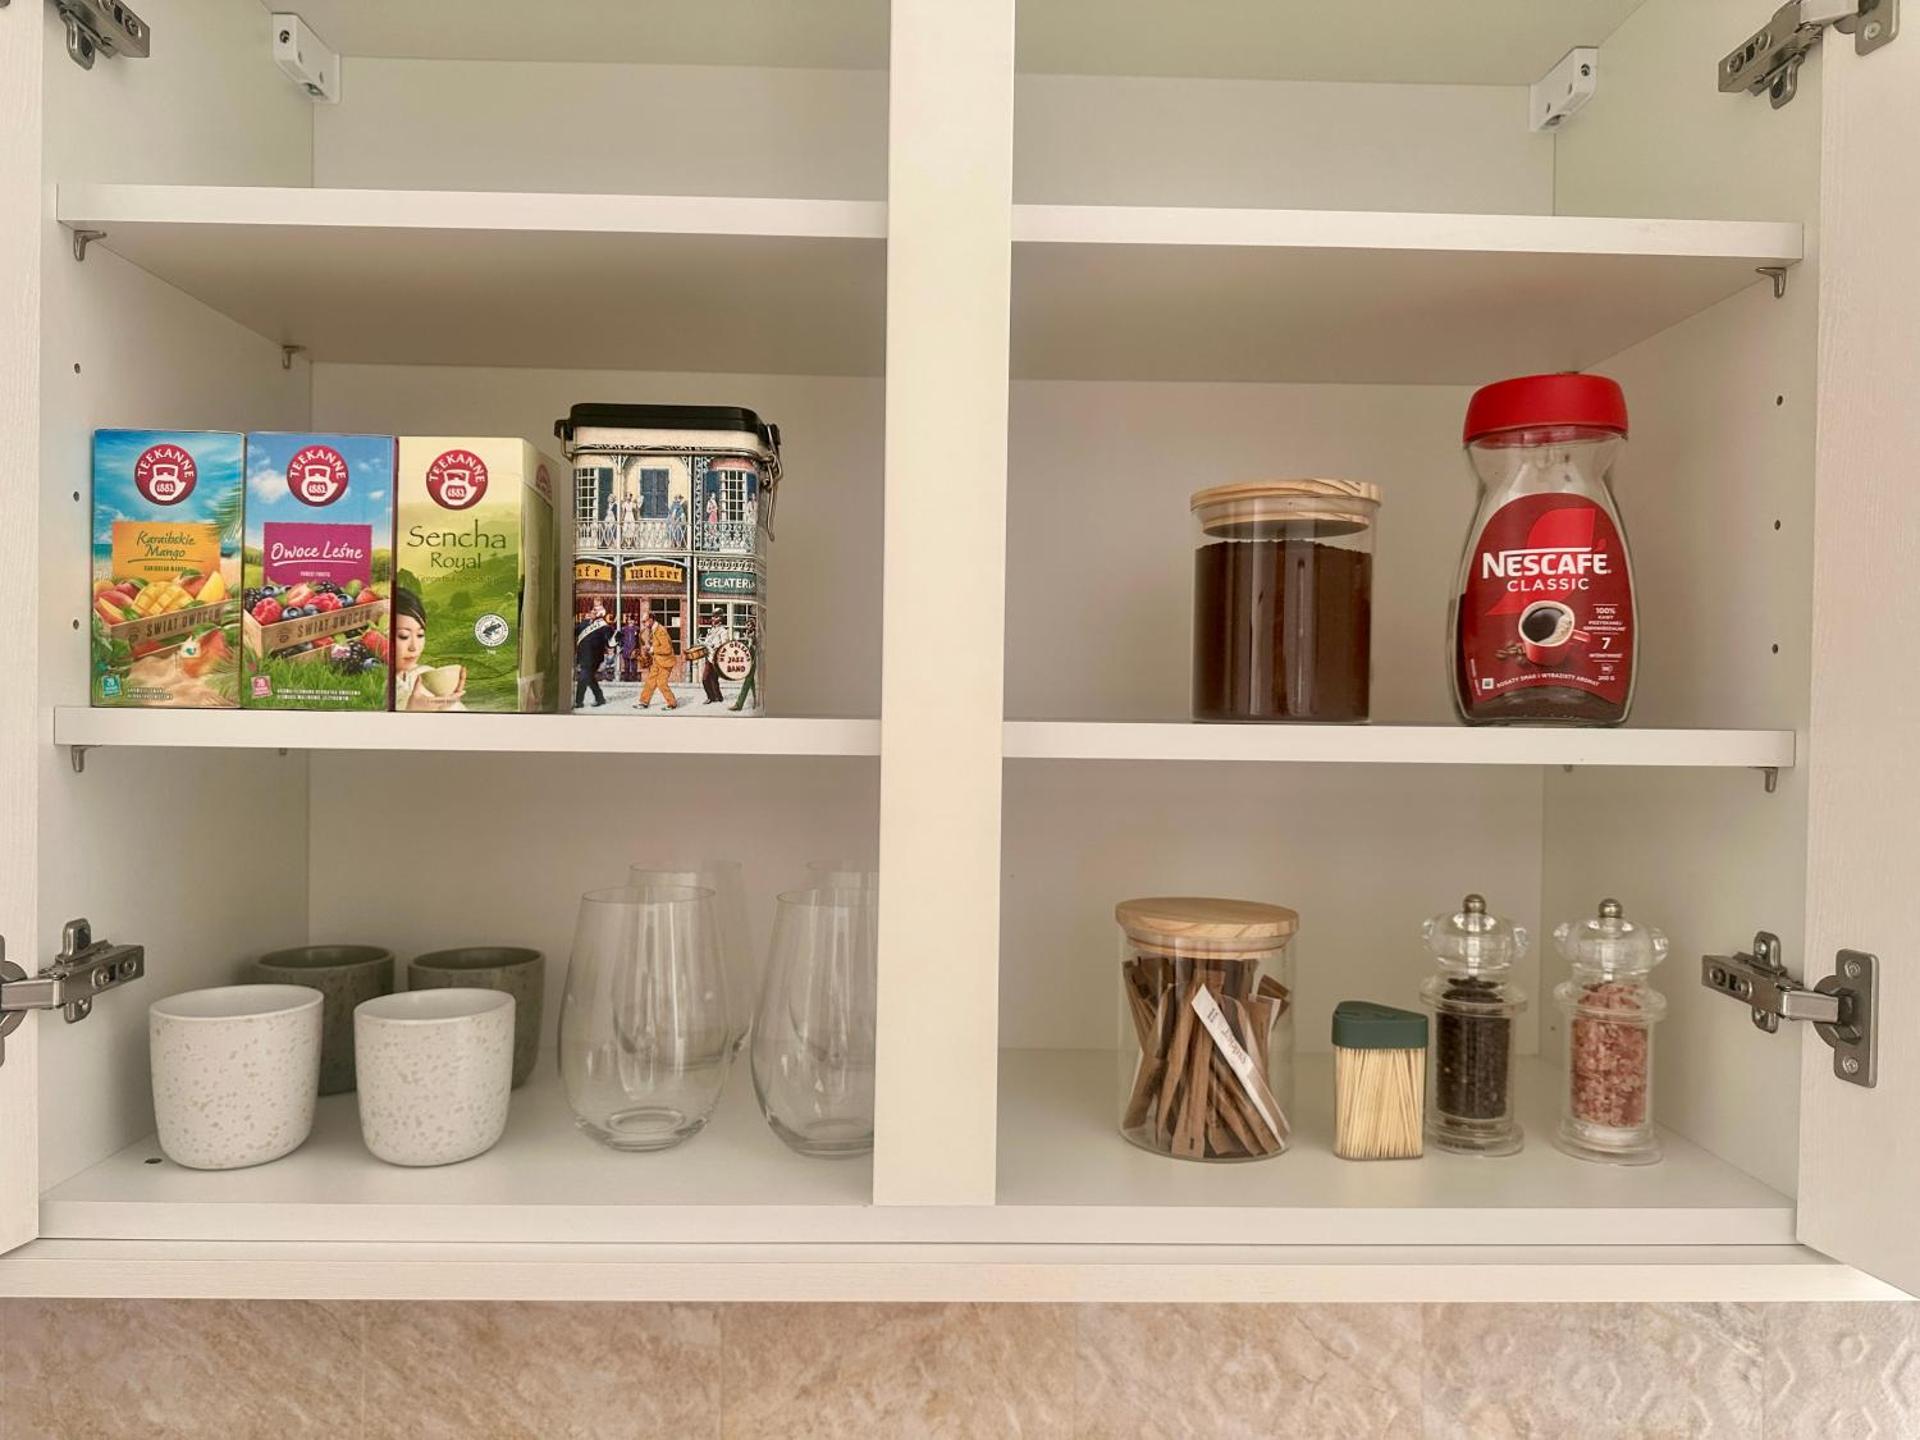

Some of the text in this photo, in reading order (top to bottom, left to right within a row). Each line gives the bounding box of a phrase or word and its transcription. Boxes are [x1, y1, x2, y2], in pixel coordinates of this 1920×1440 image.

[138, 448, 195, 478] TEEKANNE
[289, 449, 346, 479] TEEKANNE
[428, 453, 486, 483] TEEKANNE
[136, 530, 196, 547] Karaibskie
[407, 518, 507, 548] Sencha
[144, 544, 186, 561] Mango
[270, 540, 364, 560] Owoce Leśne
[430, 552, 481, 573] Royal
[630, 565, 680, 579] Walzer
[1507, 577, 1590, 592] CLASSIC
[1601, 637, 1611, 650] 7
[727, 656, 745, 664] JAZZ
[727, 665, 746, 673] BAND
